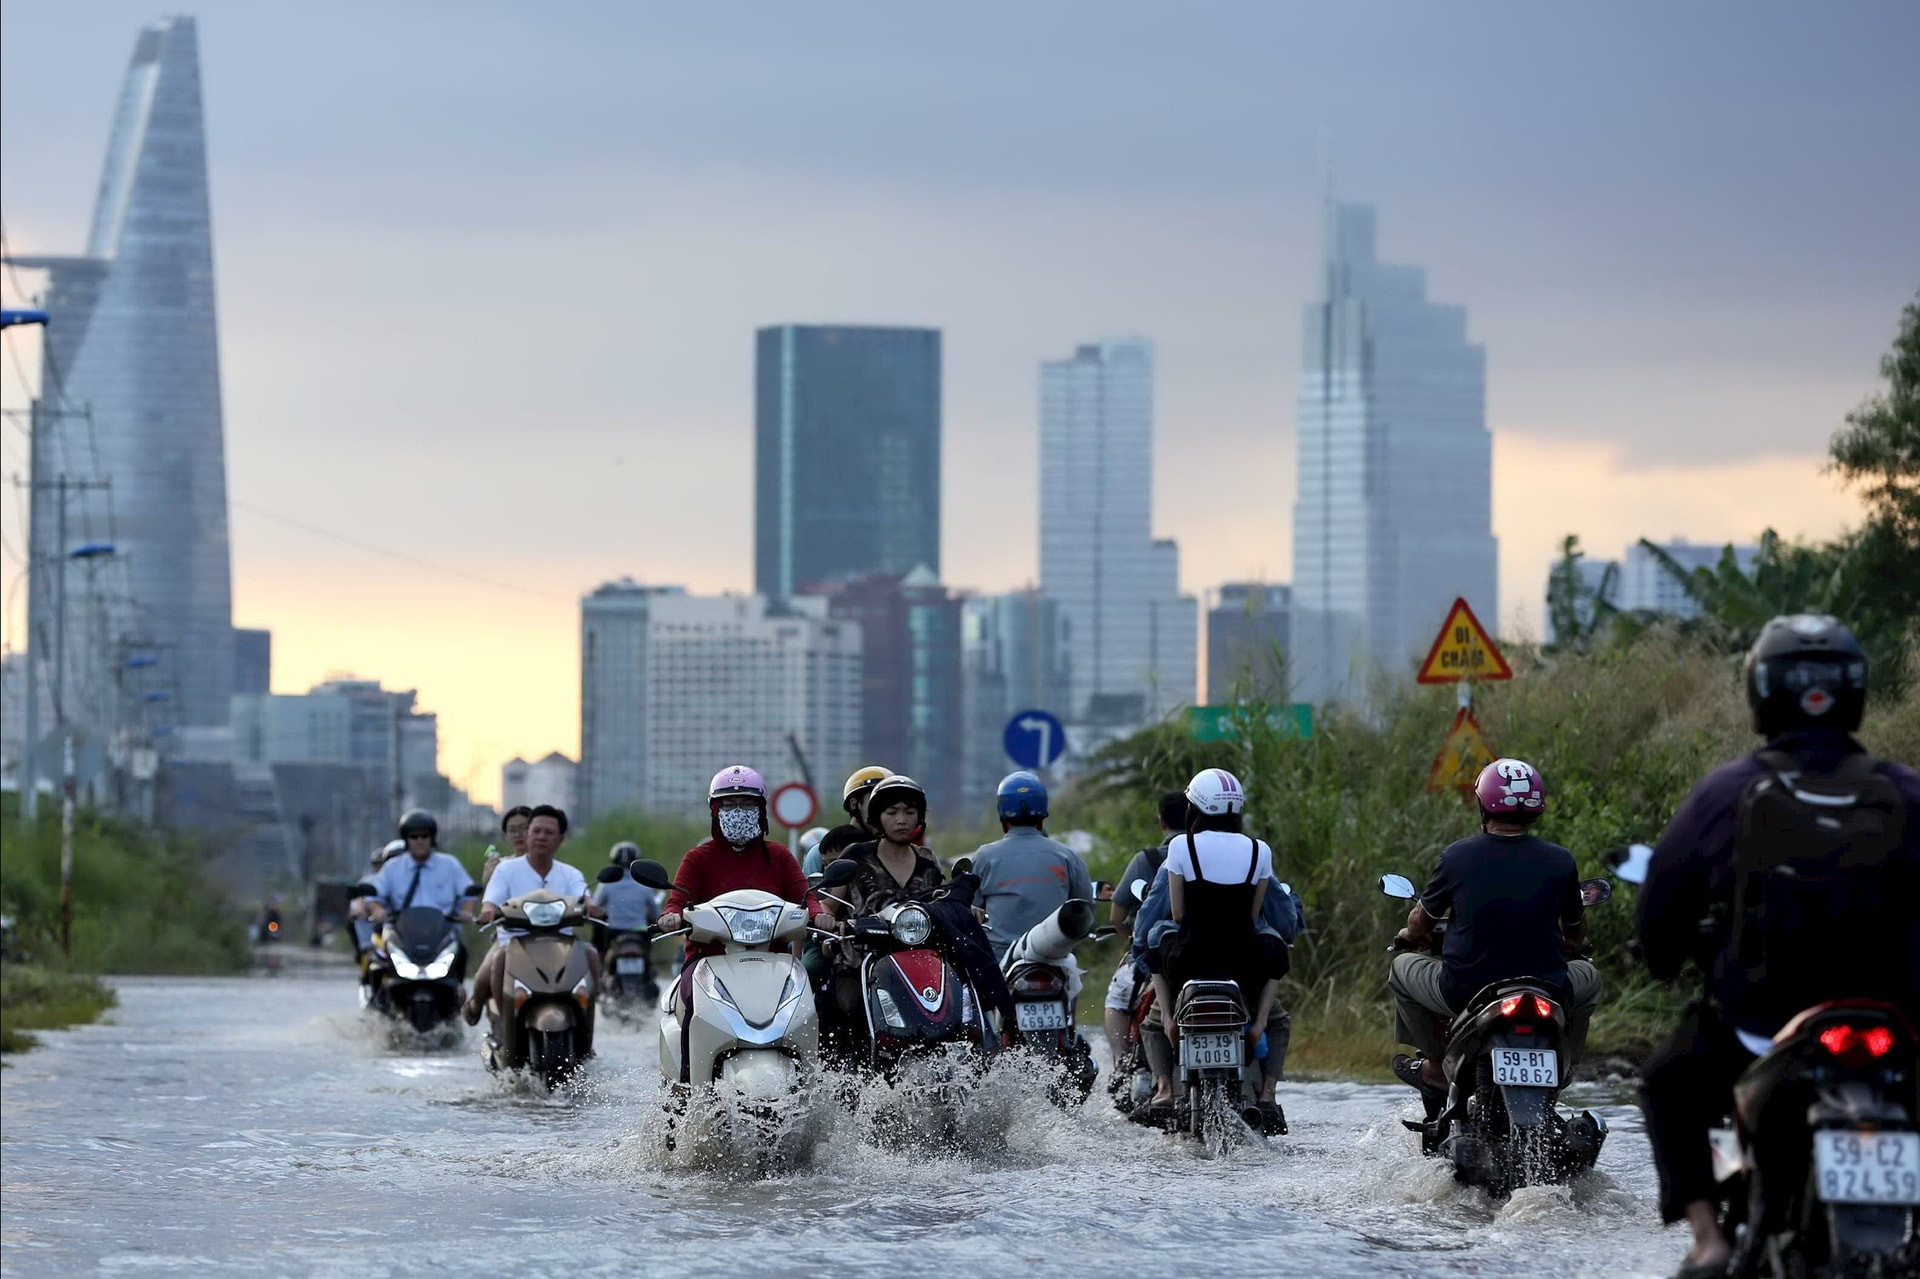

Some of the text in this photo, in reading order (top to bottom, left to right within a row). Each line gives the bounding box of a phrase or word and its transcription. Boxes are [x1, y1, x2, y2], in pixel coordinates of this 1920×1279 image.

[1023, 1003, 1055, 1016] 59-P1
[1021, 1015, 1062, 1028] 469.32
[1193, 1035, 1230, 1049] 53-X9
[1195, 1049, 1230, 1064] 4009
[1503, 1051, 1544, 1067] 59-B1
[1498, 1067, 1553, 1084] 348.62
[1832, 1135, 1905, 1167] 59-C2
